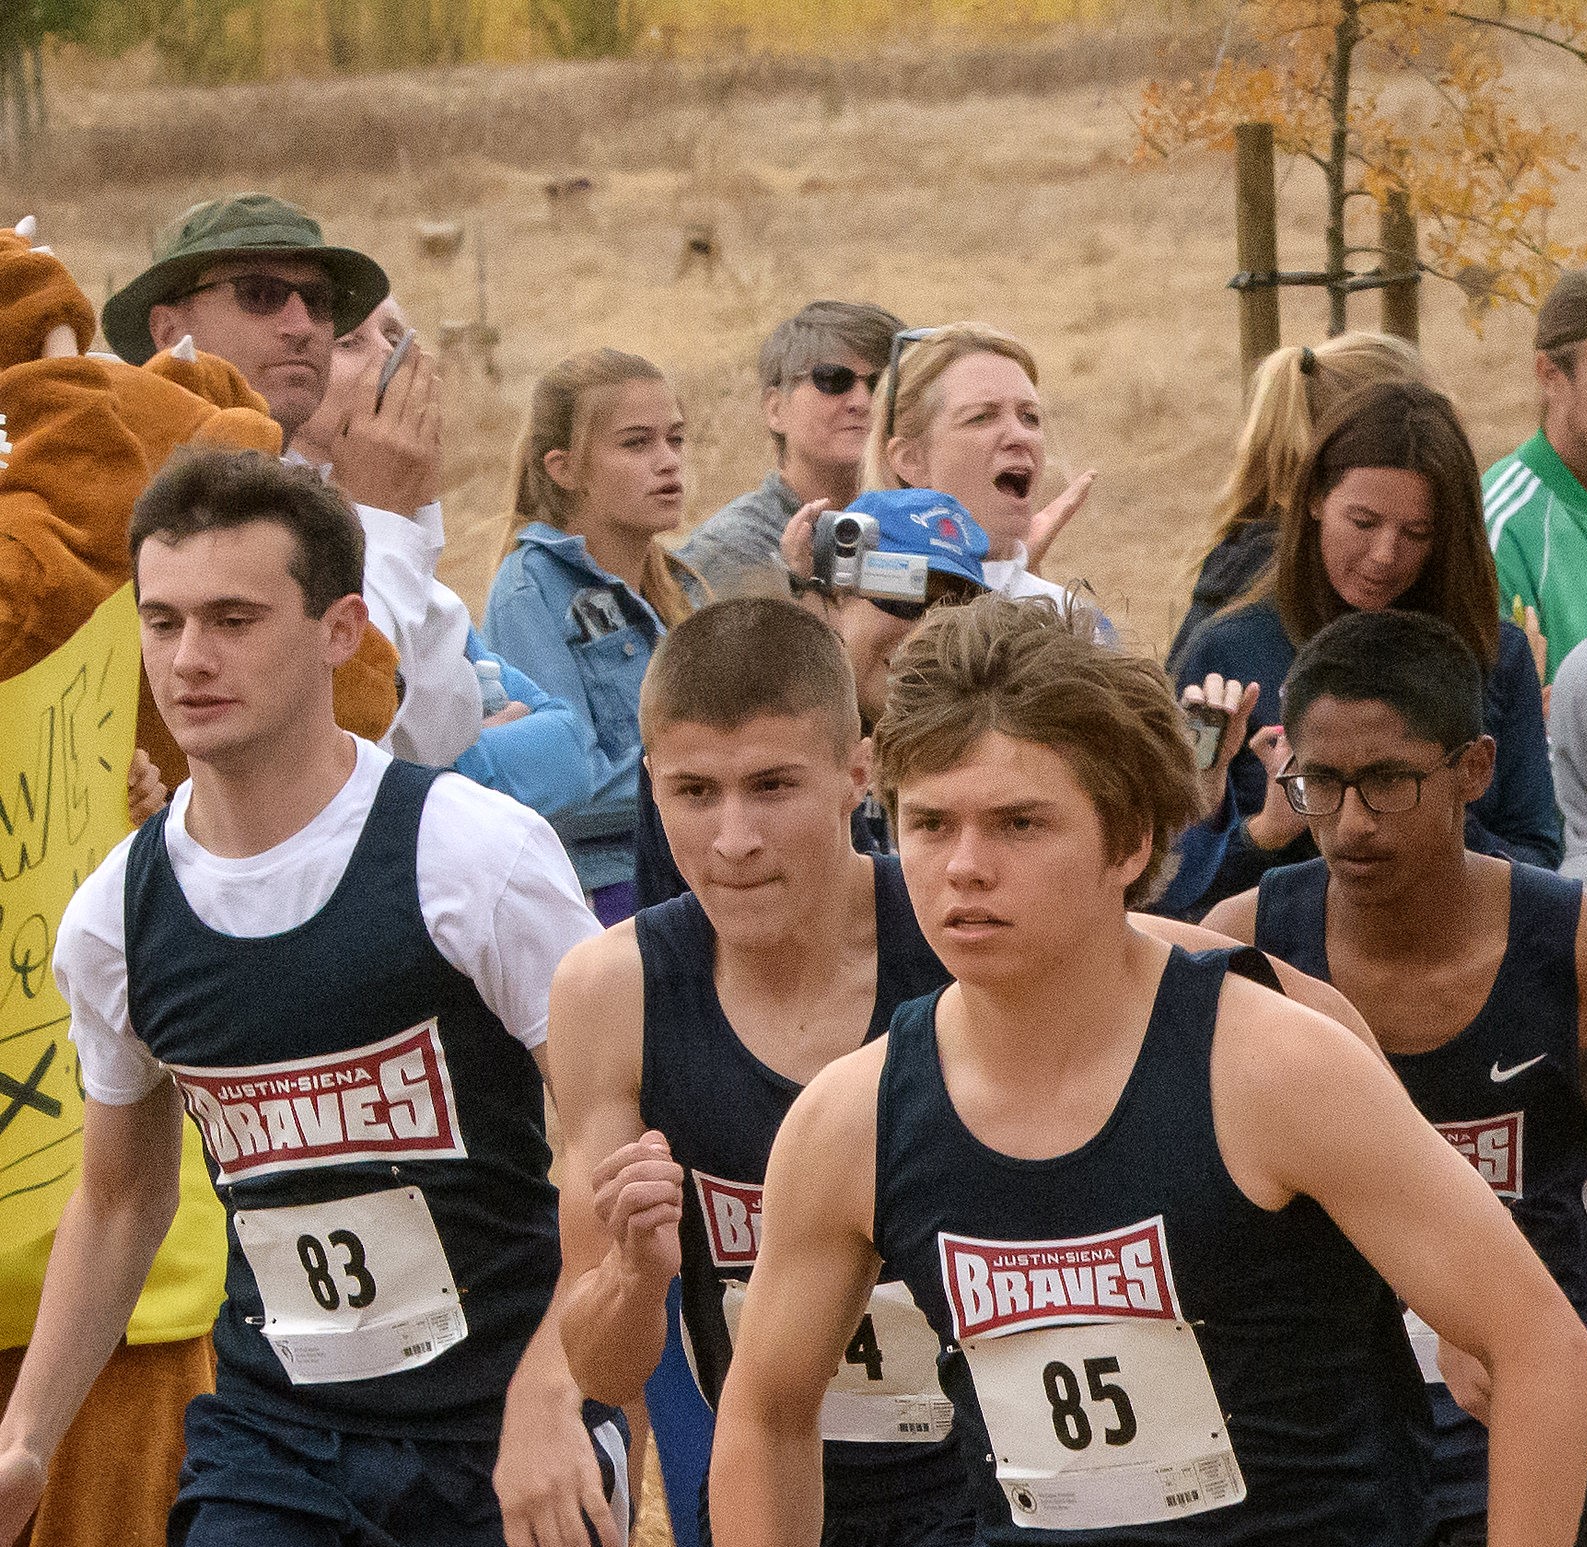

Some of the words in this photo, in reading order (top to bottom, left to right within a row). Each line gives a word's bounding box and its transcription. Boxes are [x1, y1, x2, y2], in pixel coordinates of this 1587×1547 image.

[178, 1047, 440, 1163] BRAVES
[217, 1065, 374, 1102] JUSTIN-SIENA
[296, 1228, 377, 1311] 83
[953, 1237, 1165, 1328] BRAVES
[993, 1247, 1116, 1268] JUSTIN-SIENA
[838, 1313, 884, 1381] 4
[1042, 1355, 1138, 1451] 85
